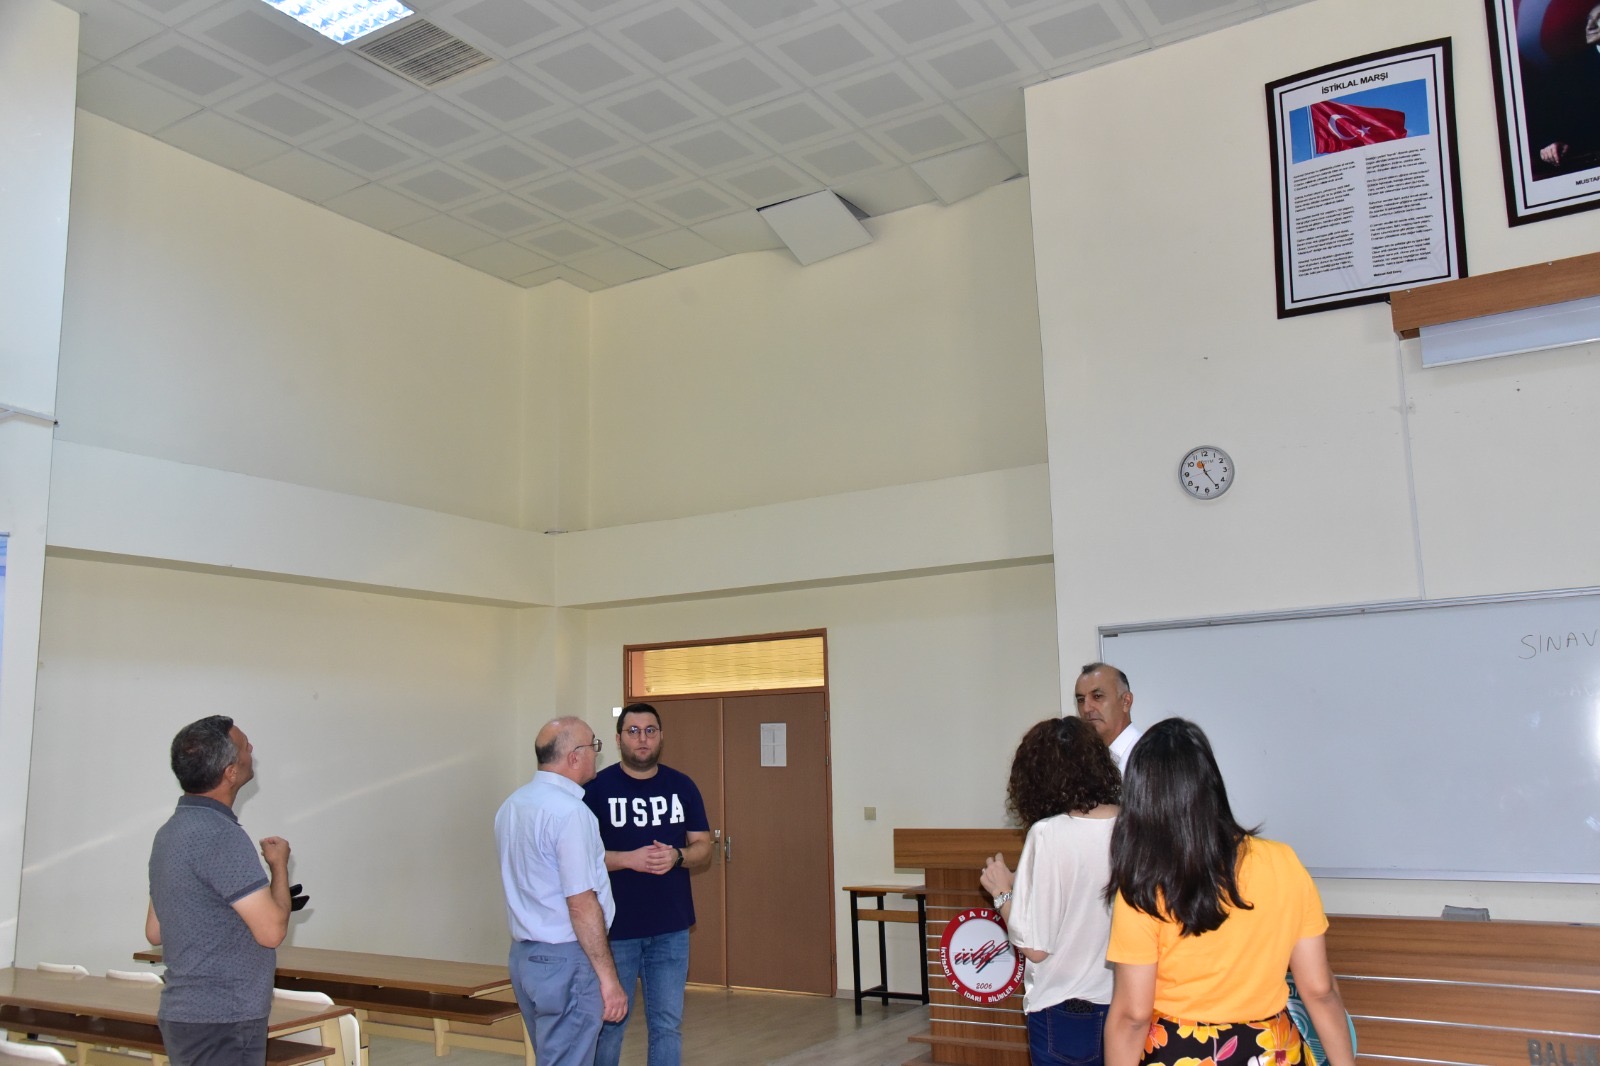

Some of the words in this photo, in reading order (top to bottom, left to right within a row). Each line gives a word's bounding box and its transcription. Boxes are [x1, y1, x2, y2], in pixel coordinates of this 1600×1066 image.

[1321, 79, 1359, 95] İSTİKLAL
[1360, 71, 1389, 85] MARŞI
[1518, 629, 1599, 660] SINAV
[607, 793, 686, 828] USPA
[951, 980, 960, 990] VE
[963, 990, 982, 1002] İDARİ
[988, 985, 1014, 1003] BİLİMLER
[975, 982, 993, 990] 2006
